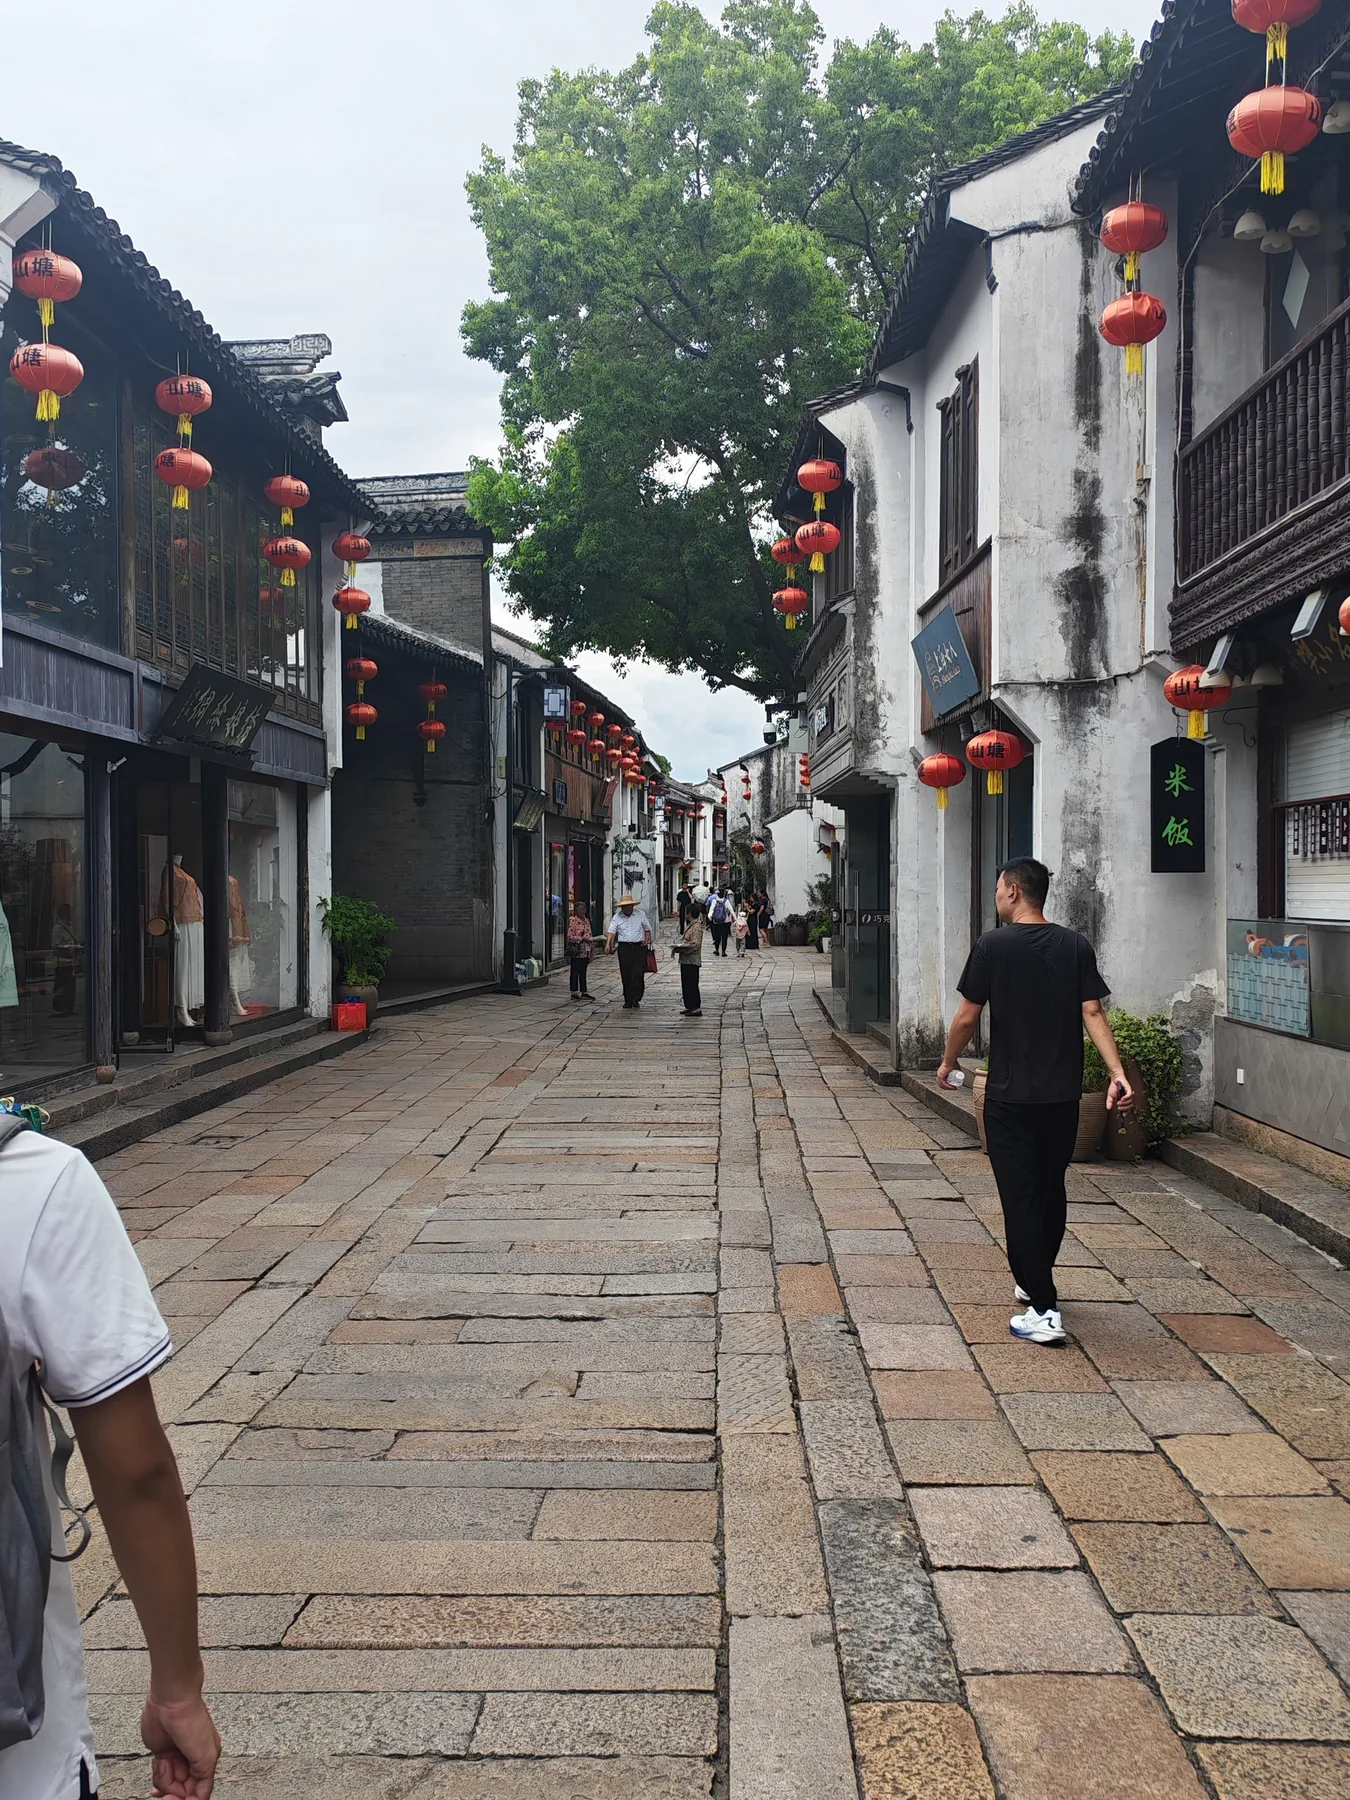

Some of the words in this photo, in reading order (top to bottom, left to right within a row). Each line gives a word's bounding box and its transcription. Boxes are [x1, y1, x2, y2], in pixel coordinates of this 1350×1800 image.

[169, 381, 203, 397] 山塘
[800, 525, 824, 540] 山塘
[271, 544, 298, 557] 山塘
[971, 742, 1004, 758] 山塘
[1162, 764, 1195, 846] 米饭
